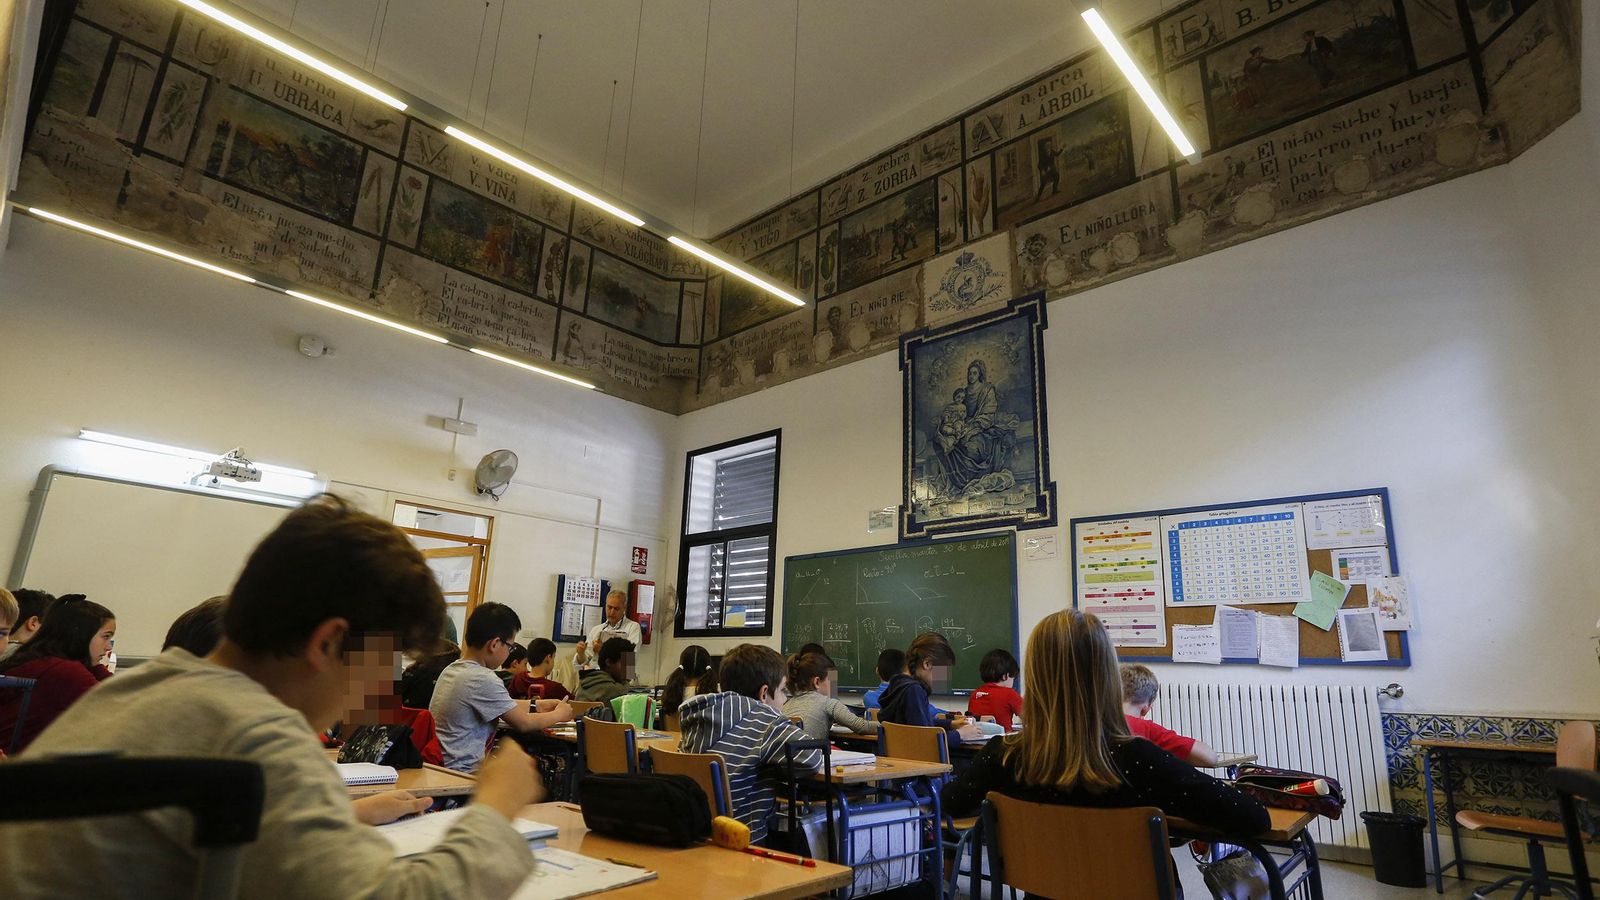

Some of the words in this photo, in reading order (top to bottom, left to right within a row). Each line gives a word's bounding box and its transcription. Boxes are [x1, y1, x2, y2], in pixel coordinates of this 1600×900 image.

[291, 70, 338, 102] urna
[1037, 67, 1084, 98] arca
[274, 80, 344, 129] URRACA
[1258, 141, 1275, 161] El
[1332, 108, 1381, 134] su-be
[1388, 98, 1401, 121] y
[877, 153, 911, 176] zebra
[1261, 158, 1279, 177] El
[1288, 142, 1351, 173] pe-rro
[1359, 129, 1383, 148] no
[488, 163, 519, 186] vaca
[874, 164, 919, 196] ZORRA
[222, 192, 240, 210] El
[485, 177, 516, 204] VIÑA
[1085, 215, 1113, 237] NIÑO
[1115, 200, 1156, 227] LLORA
[753, 229, 780, 251] YUGO
[442, 285, 455, 301] El
[444, 271, 458, 288] La
[437, 311, 450, 328] El
